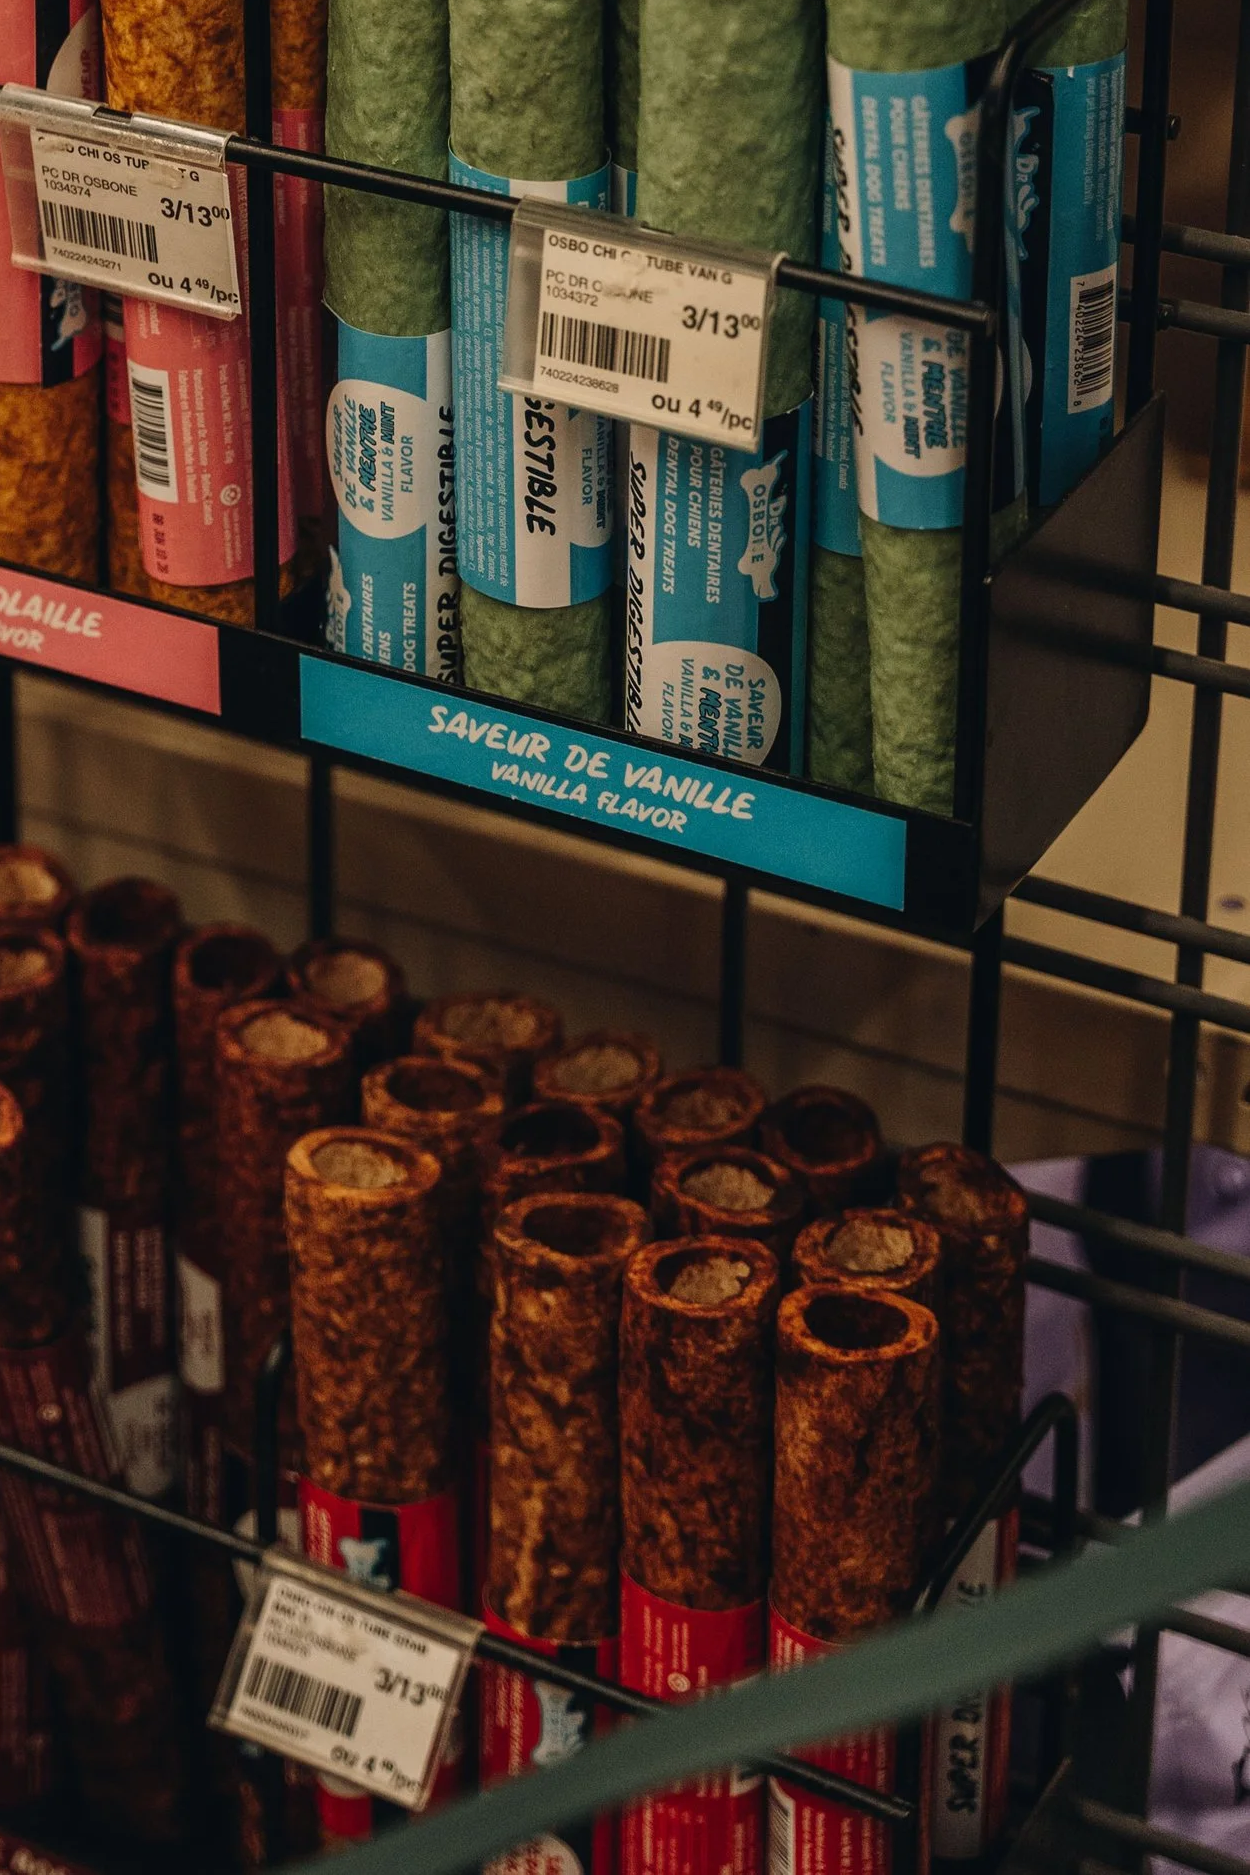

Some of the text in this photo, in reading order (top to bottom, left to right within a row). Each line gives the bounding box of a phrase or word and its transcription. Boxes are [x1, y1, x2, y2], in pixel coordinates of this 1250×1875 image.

[41, 164, 59, 180] PC
[62, 170, 81, 184] DR
[83, 174, 138, 198] OSBONE
[43, 178, 91, 198] 1034374
[78, 145, 100, 160] CHI
[103, 151, 121, 166] OS
[861, 96, 888, 266] DENTAL DOG TREATS
[890, 97, 912, 211] POUR CHIENS
[52, 247, 122, 271] 740224243271
[547, 234, 589, 254] OSBO
[592, 244, 617, 260] CHI
[645, 255, 684, 274] TUBE
[688, 263, 718, 282] VAN
[720, 272, 733, 285] G
[915, 178, 937, 269] DENTAIRES
[148, 272, 174, 290] ou
[180, 277, 192, 294] 4
[546, 270, 588, 290] PC DR
[546, 285, 599, 307] 1034372
[540, 366, 619, 394] 740224238628
[1073, 305, 1086, 385] 40224 23862
[651, 394, 681, 414] ou
[688, 399, 701, 418] 4
[880, 361, 897, 424] FLAVOR
[900, 332, 921, 460] VANILLA MINT
[922, 338, 948, 449] & MENTHE
[950, 368, 968, 449] VANILLE
[331, 403, 345, 483] SAVEUR
[343, 393, 358, 511] DE VANILLE
[358, 404, 377, 515] & MENTHE
[379, 400, 396, 522] VANILLA MINT
[400, 434, 414, 495] FLAVOR
[581, 447, 593, 506] FLAVOR
[629, 451, 647, 561] SUPER
[662, 436, 680, 596] DENTAL DOG TREATS
[687, 445, 703, 549] POUR CHIENS
[706, 447, 727, 604] GÂTERIES DENTAIRES
[436, 404, 460, 684] SUPER DIGESTIBLE
[361, 572, 374, 656] DENTAIRES
[402, 581, 417, 672] DOG TREATS
[661, 680, 674, 740] FLAVOR
[680, 658, 695, 718] VANILLA
[702, 665, 721, 682] &
[722, 663, 745, 759] DE VANILL
[746, 677, 766, 750] SAVEUR
[427, 704, 758, 822] SAVEUR DE VANILLE
[490, 760, 690, 835] VANILLA FLAVOR
[946, 1734, 978, 1815] SUPER
